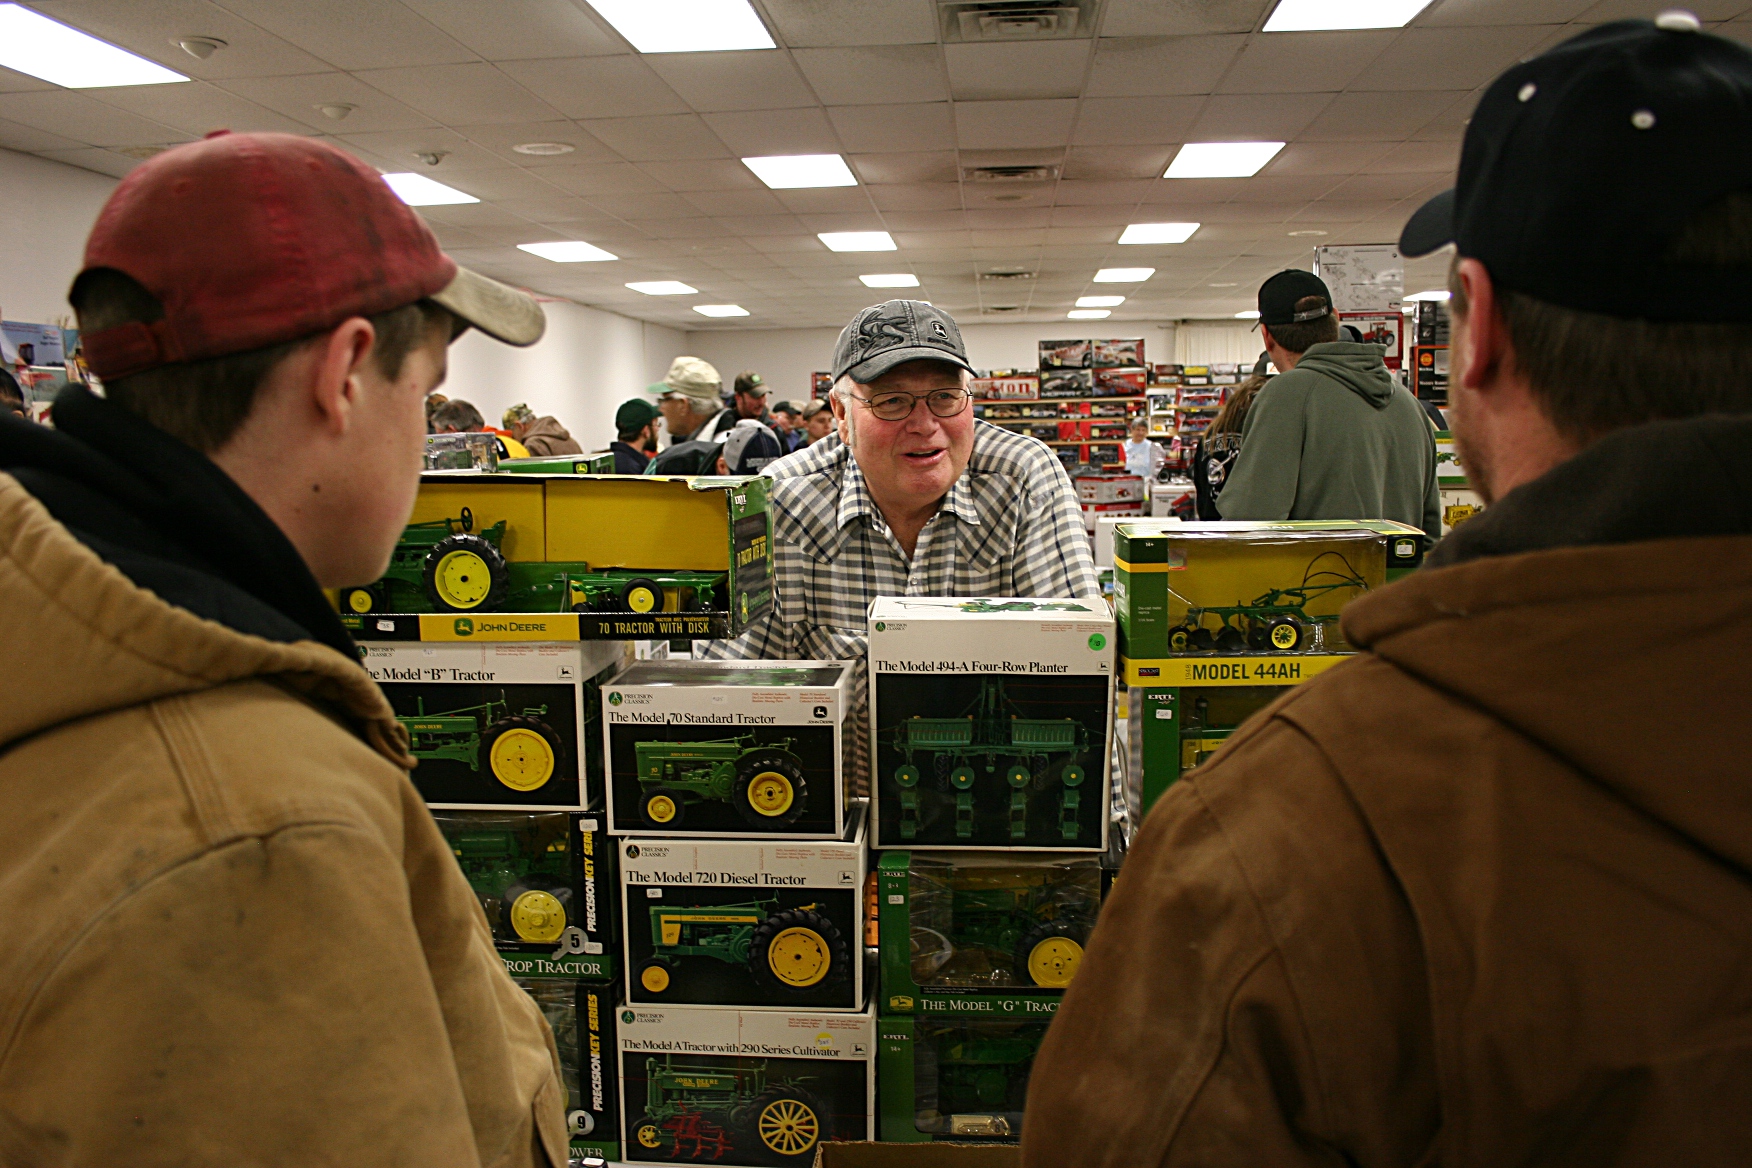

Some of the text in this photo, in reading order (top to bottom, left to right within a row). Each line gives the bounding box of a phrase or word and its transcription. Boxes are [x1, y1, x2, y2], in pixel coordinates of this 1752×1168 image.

[477, 622, 546, 632] JOHN DEERE
[599, 622, 709, 634] 70 TRACTOR WITH DISK
[876, 660, 1068, 673] The Model 494-A Four-Row Planter
[1193, 663, 1300, 680] MODEL 44AH
[383, 667, 421, 681] Model
[449, 668, 495, 681] Tractor
[609, 712, 776, 724] The Model 70 Standard Tractor
[626, 870, 807, 885] The Model 720 Diesel Tractor
[571, 933, 580, 948] 5
[501, 958, 602, 974] ROP TRACTOR
[921, 999, 946, 1010] THE
[950, 1000, 993, 1011] MODEL
[998, 1000, 1020, 1011] "G"
[587, 993, 599, 1032] SERIES
[622, 1038, 840, 1057] The Model A Tractor with 290 Series Cultivator
[577, 1115, 586, 1129] 9
